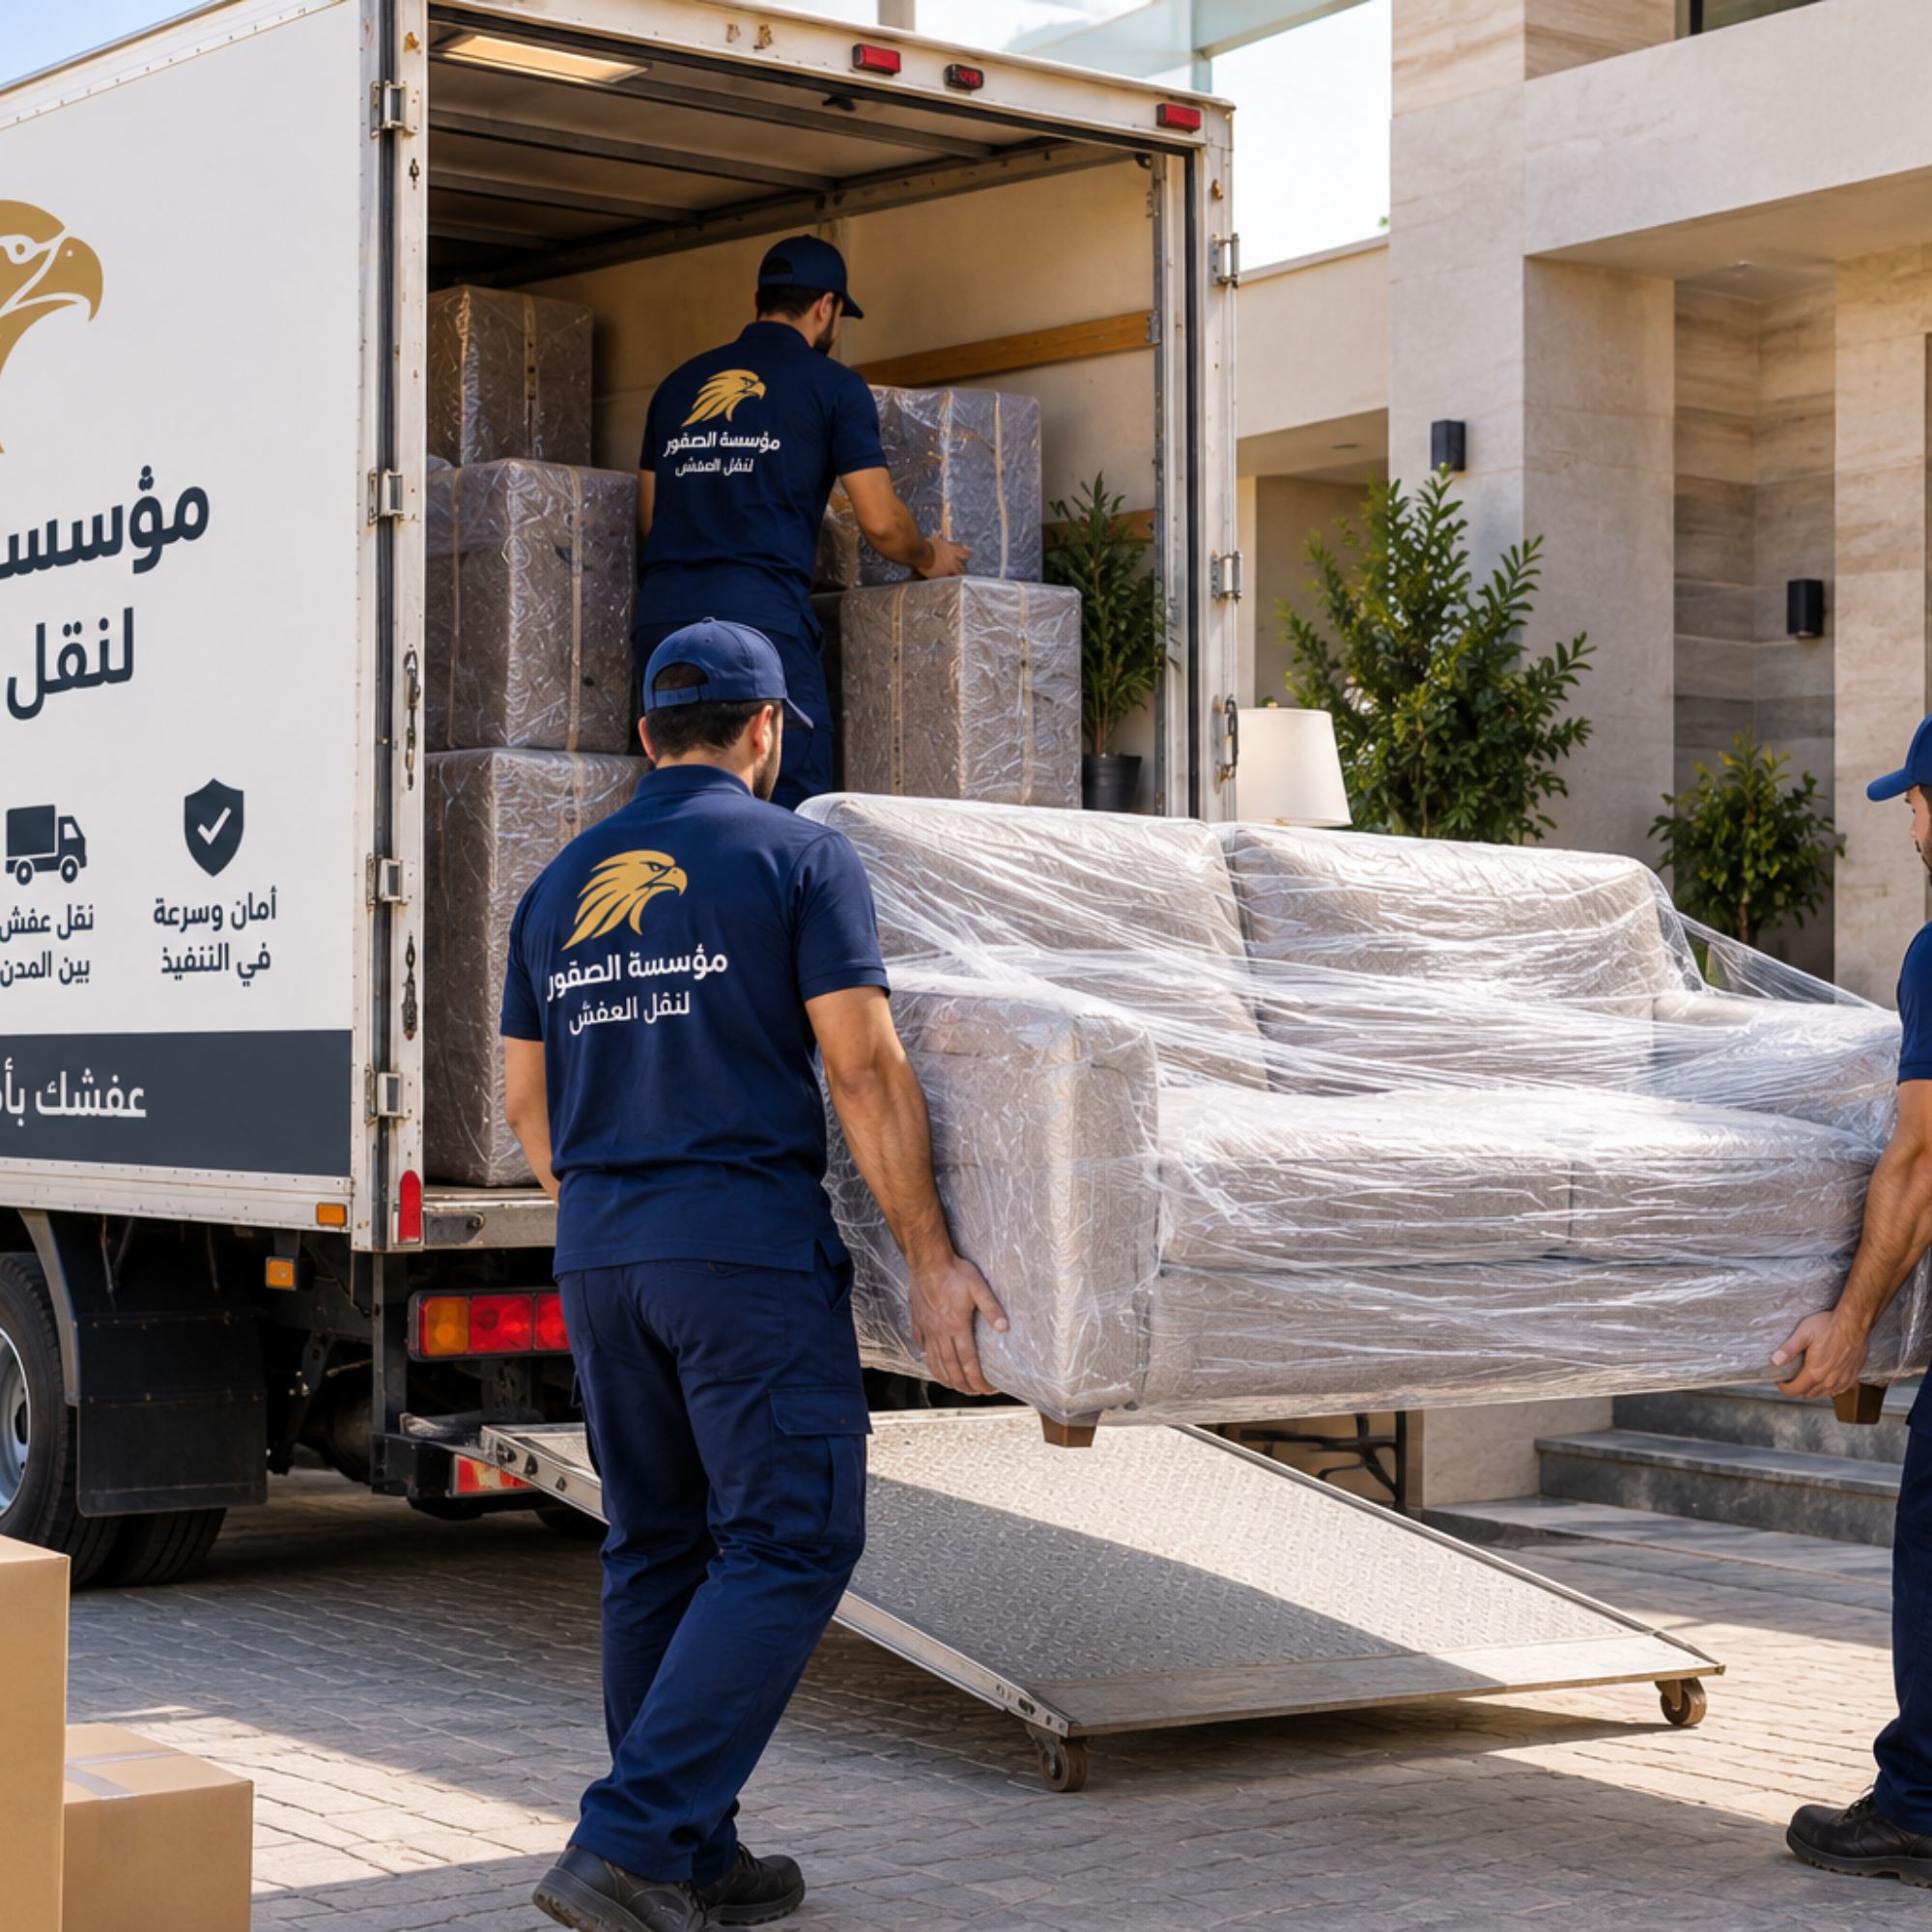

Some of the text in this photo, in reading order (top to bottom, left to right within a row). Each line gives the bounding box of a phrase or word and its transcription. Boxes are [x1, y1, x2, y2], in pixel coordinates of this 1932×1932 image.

[719, 431, 781, 453] مؤسسة
[0, 465, 210, 580] مؤسس
[7, 607, 134, 720] لنقل
[0, 903, 94, 943] نقل عفش
[153, 885, 277, 932] أمان وسرعة
[0, 950, 91, 987] بين المدن
[236, 942, 271, 987] في
[546, 944, 728, 1003] مؤسسة الصقور
[569, 990, 691, 1036] لنقل العفش
[35, 1067, 147, 1118] عفشك
